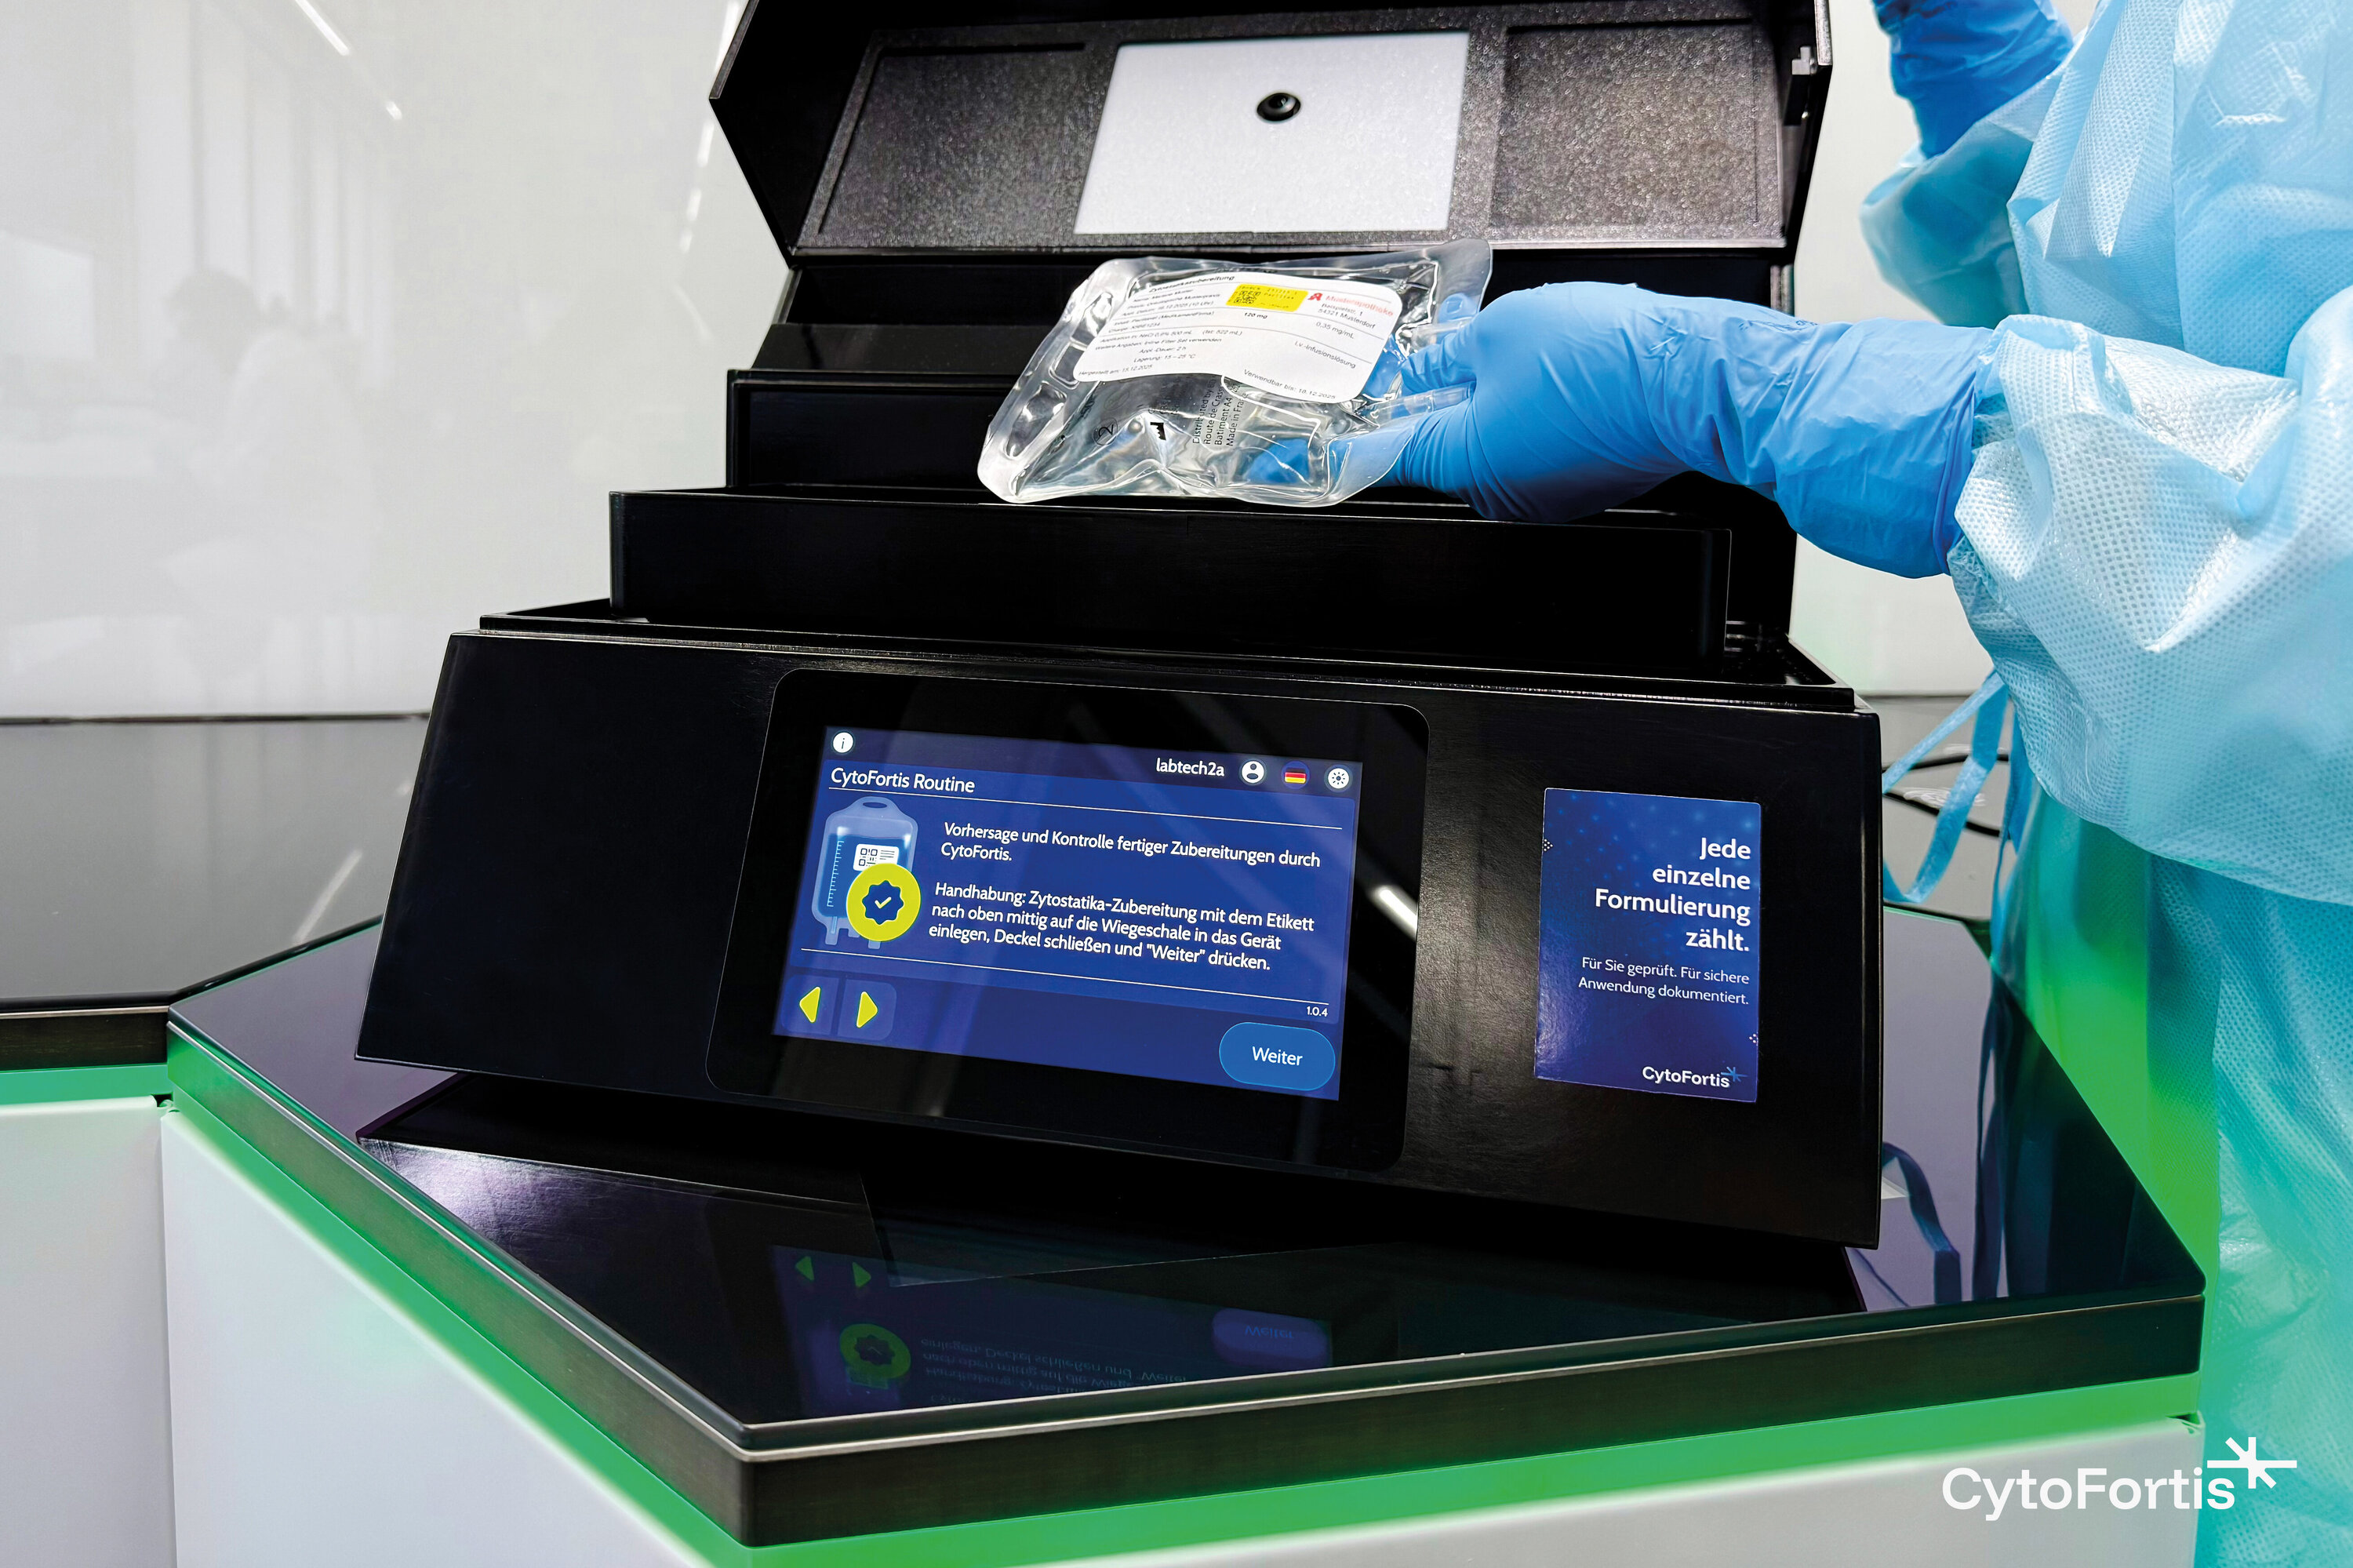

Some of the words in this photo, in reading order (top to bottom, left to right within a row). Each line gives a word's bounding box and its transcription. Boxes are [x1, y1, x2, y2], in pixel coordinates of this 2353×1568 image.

[1318, 308, 1339, 318] 54321
[1340, 311, 1377, 329] Musterdorf
[1332, 326, 1355, 340] mg/mL
[1244, 369, 1282, 388] Verwendbar
[1211, 387, 1224, 408] Crass
[1209, 408, 1218, 419] de
[1214, 411, 1230, 446] Batiment
[1224, 396, 1233, 408] A4
[1203, 419, 1215, 445] Route
[1225, 422, 1238, 446] Made
[1156, 758, 1225, 777] labtech2a
[831, 767, 910, 788] CytoFortis
[914, 773, 976, 793] Routine
[940, 842, 1013, 861] CytoFortis.
[944, 821, 1019, 845] Vorhersage
[1021, 829, 1049, 844] und
[1051, 831, 1114, 849] Kontrolle
[1117, 835, 1169, 857] fertiger
[1169, 840, 1275, 866] Zubereitungen
[1278, 849, 1321, 868] durch
[1699, 837, 1751, 860] Jede
[1652, 864, 1751, 890] einzelne
[934, 882, 1027, 908] Handhabung:
[1028, 890, 1197, 924] Zytostatika-Zubereitung
[1199, 908, 1226, 923] mit
[1227, 908, 1263, 926] dem
[1266, 912, 1315, 932] Etikett
[1595, 888, 1751, 927] Formulierung
[931, 904, 965, 919] nach
[967, 906, 1003, 922] oben
[1006, 911, 1049, 931] mittig
[1049, 915, 1075, 930] auf
[1075, 915, 1098, 933] die
[1100, 918, 1191, 941] Wiegeschale
[1194, 927, 1208, 943] in
[1211, 928, 1238, 946] das
[1240, 931, 1282, 951] Gerät
[929, 923, 991, 944] einlegen,
[993, 928, 1041, 948] Deckel
[1043, 933, 1111, 955] schließen
[1114, 941, 1144, 957] und
[1146, 943, 1206, 963] "Weiter"
[1207, 949, 1271, 971] drücken.
[1686, 928, 1751, 952] zählt.
[1581, 956, 1602, 970] Für
[1604, 959, 1625, 973] Sie
[1627, 963, 1678, 979] geprüft.
[1680, 966, 1701, 980] Für
[1703, 969, 1750, 985] sichere
[1577, 976, 1656, 999] Anwendung
[1657, 984, 1750, 1006] dokumentiert.
[1306, 1006, 1329, 1017] 1.0.4
[1252, 1046, 1304, 1066] Weiter
[1642, 1066, 1731, 1089] CytoFortis
